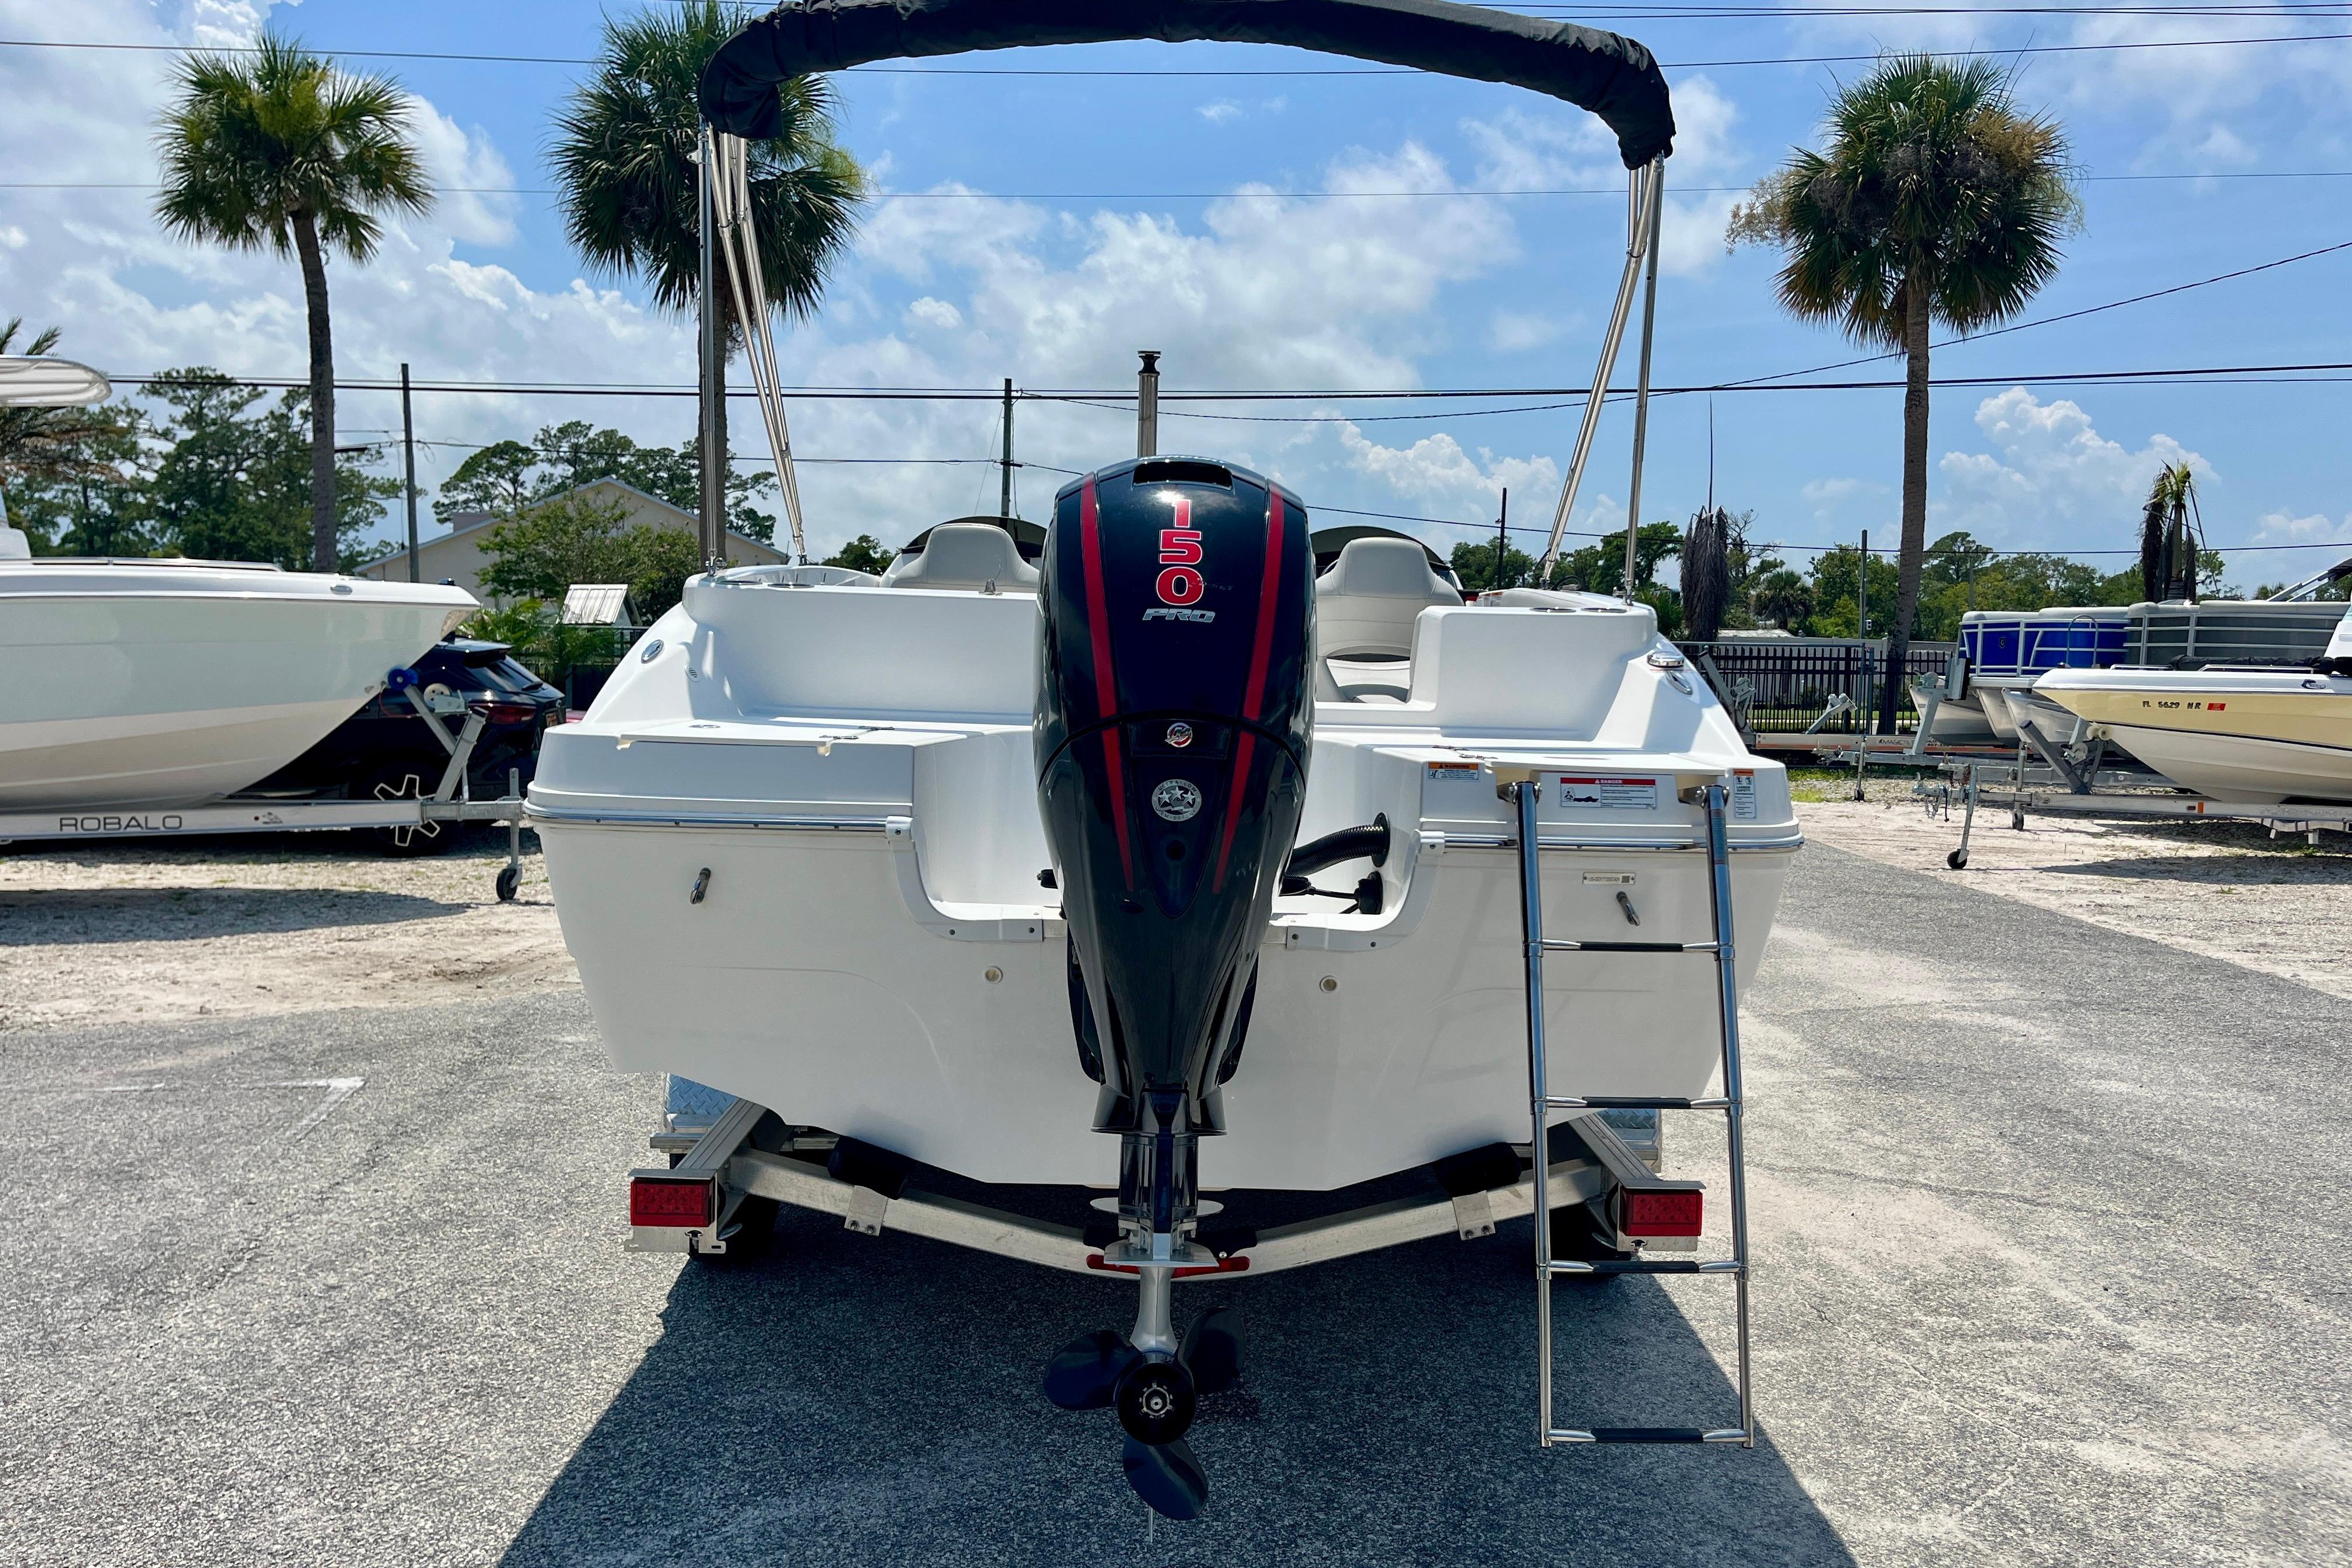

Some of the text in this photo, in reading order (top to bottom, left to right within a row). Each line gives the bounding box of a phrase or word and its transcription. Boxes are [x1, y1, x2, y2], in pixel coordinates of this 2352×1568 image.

[1156, 499, 1205, 606] 150
[1142, 608, 1216, 623] PRO
[60, 816, 183, 832] ROBALO
